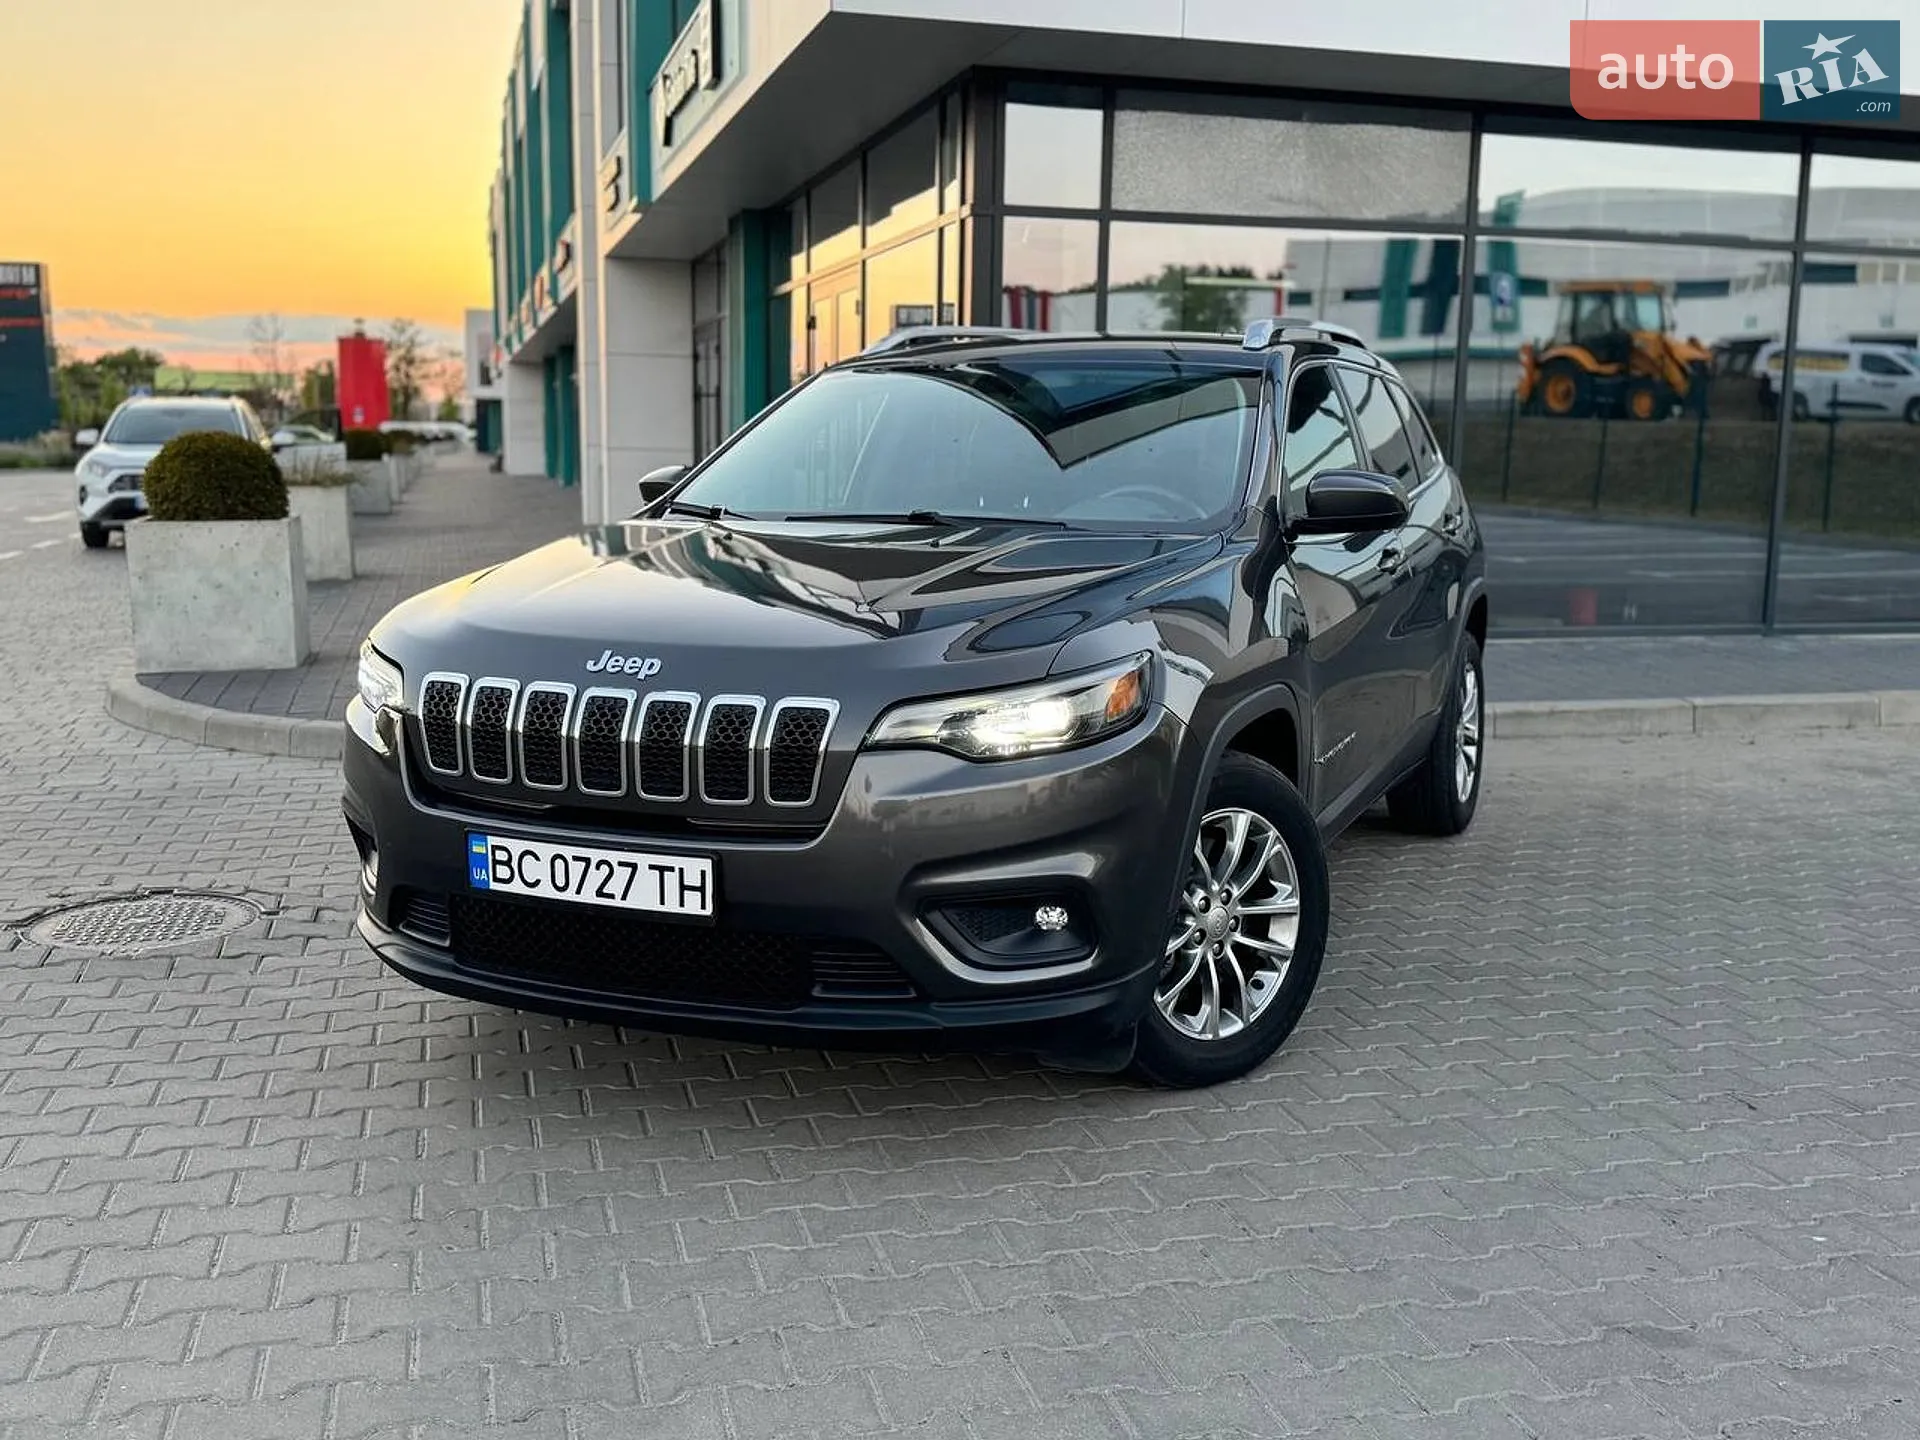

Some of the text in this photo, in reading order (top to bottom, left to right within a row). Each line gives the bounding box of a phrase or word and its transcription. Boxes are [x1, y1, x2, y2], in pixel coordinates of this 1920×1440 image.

[586, 649, 662, 680] Jeep
[473, 866, 489, 882] UA
[490, 844, 708, 911] BC 0727 TH
